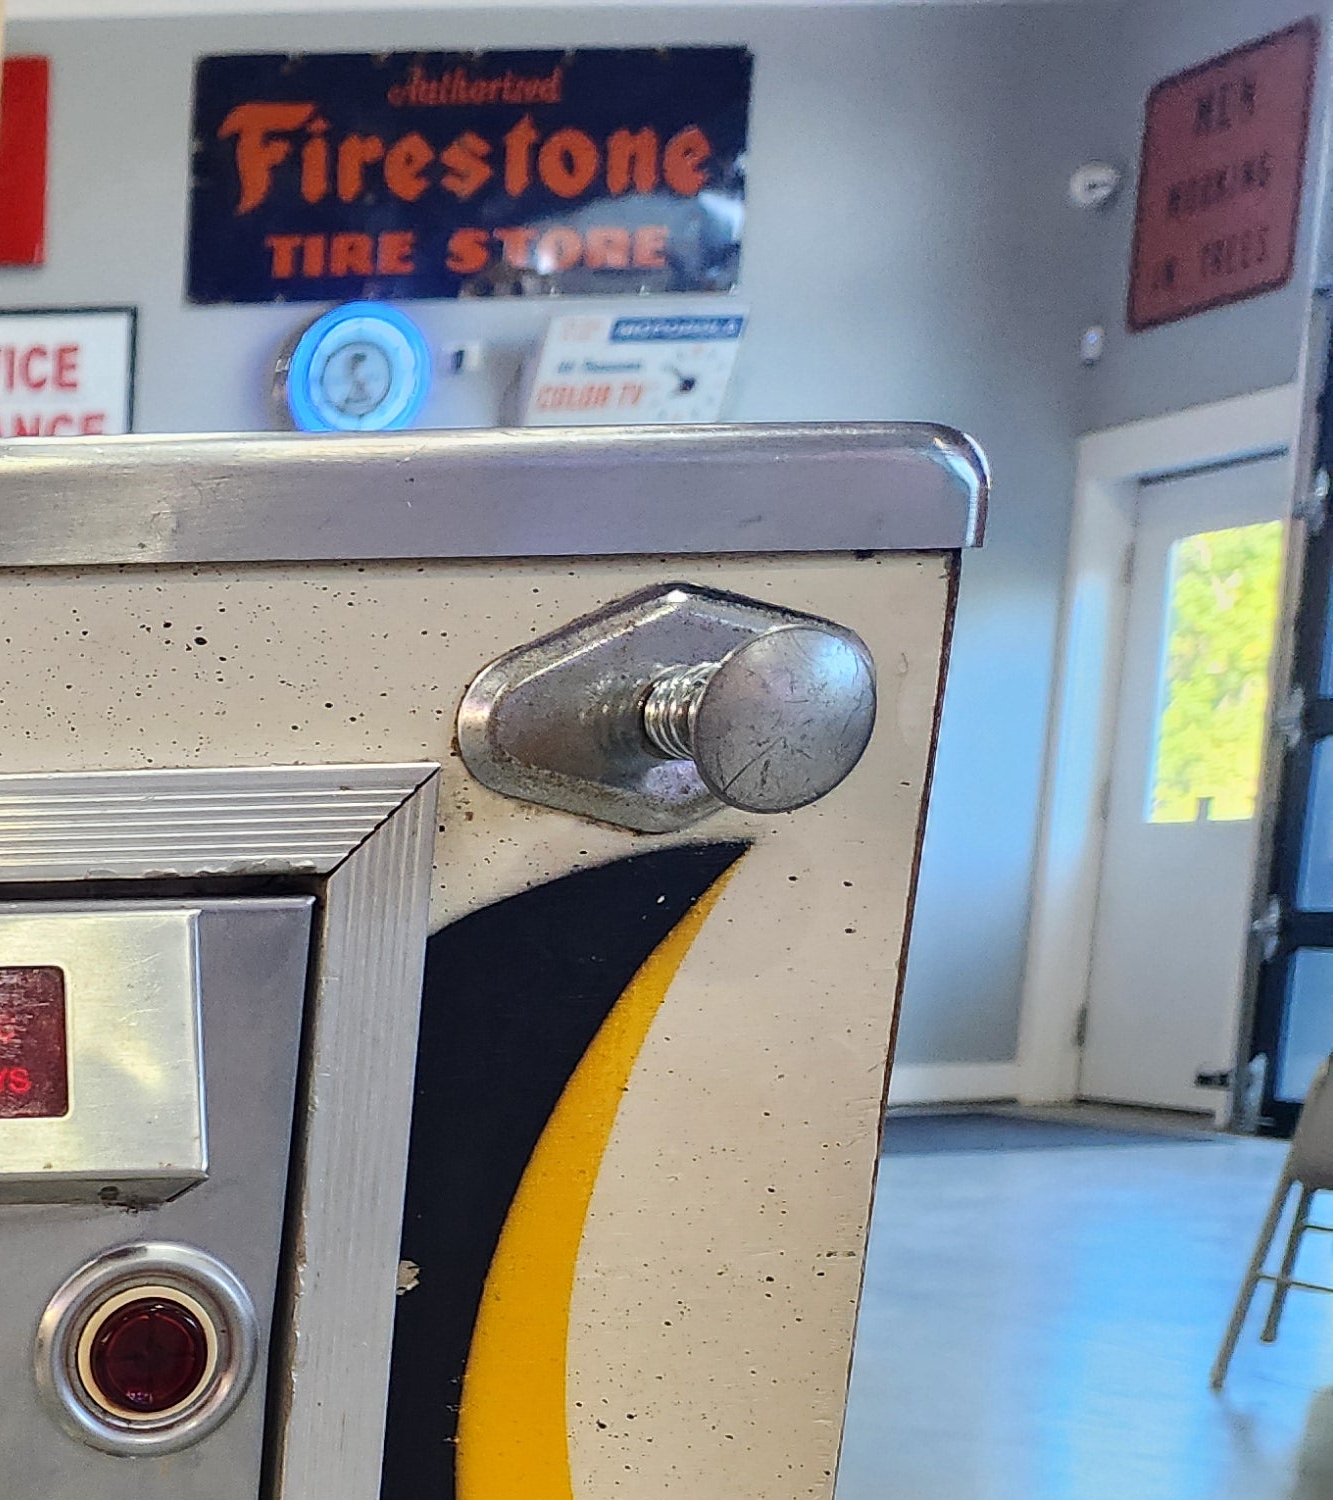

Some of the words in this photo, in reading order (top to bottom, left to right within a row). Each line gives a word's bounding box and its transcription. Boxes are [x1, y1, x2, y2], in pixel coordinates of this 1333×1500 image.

[387, 66, 562, 106] Authorized
[216, 103, 712, 214] Firestone
[264, 231, 417, 278] TIRE
[445, 226, 670, 275] STORE
